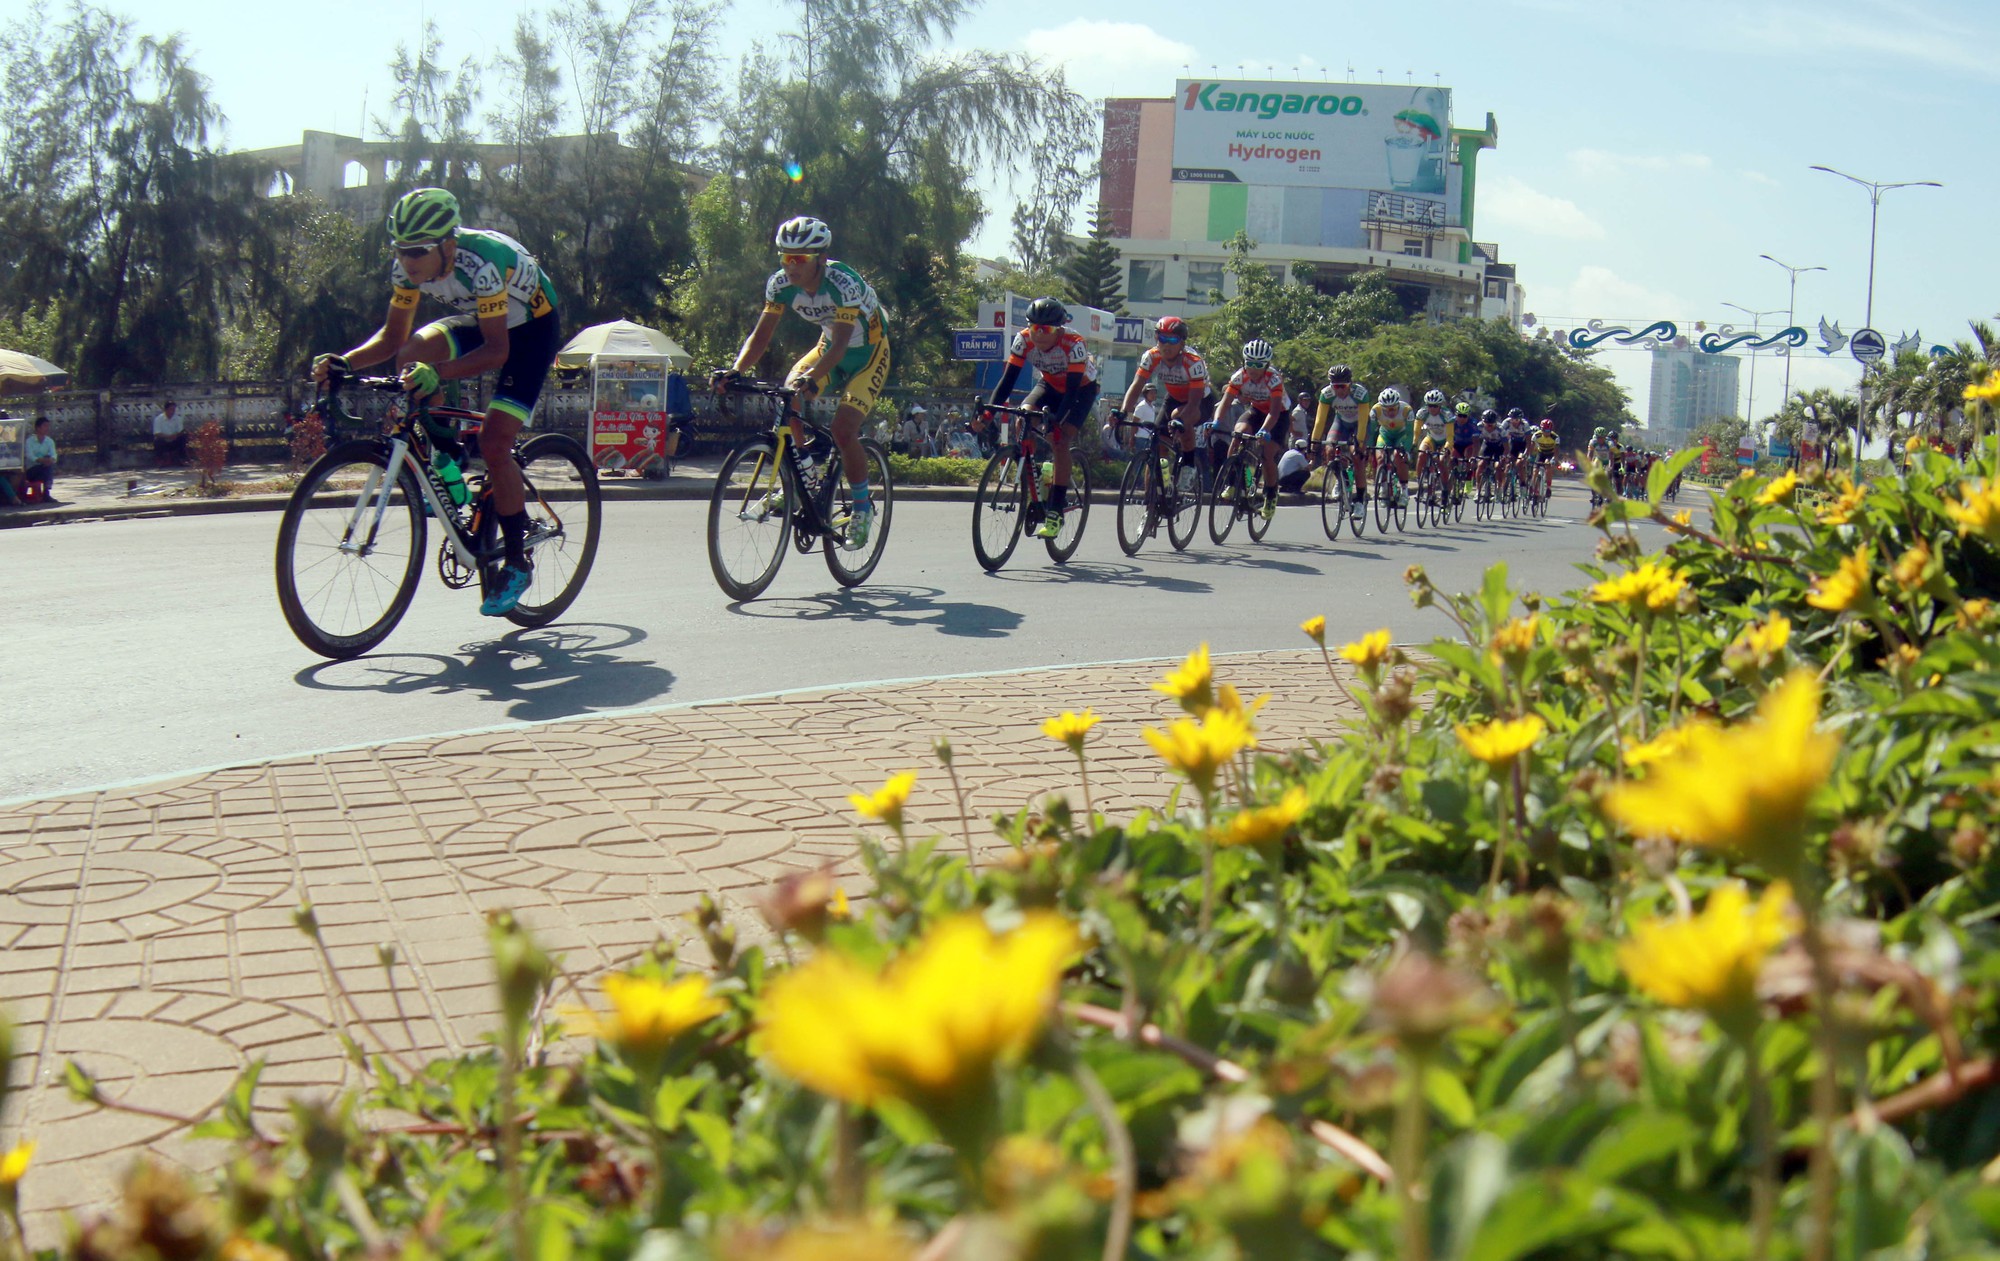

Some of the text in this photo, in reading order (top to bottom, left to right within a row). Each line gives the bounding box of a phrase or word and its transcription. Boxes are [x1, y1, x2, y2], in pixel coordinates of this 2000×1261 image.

[1228, 143, 1321, 163] Hydrogen
[982, 339, 997, 349] PHÚ
[1072, 347, 1084, 359] 16
[1193, 364, 1203, 376] 12
